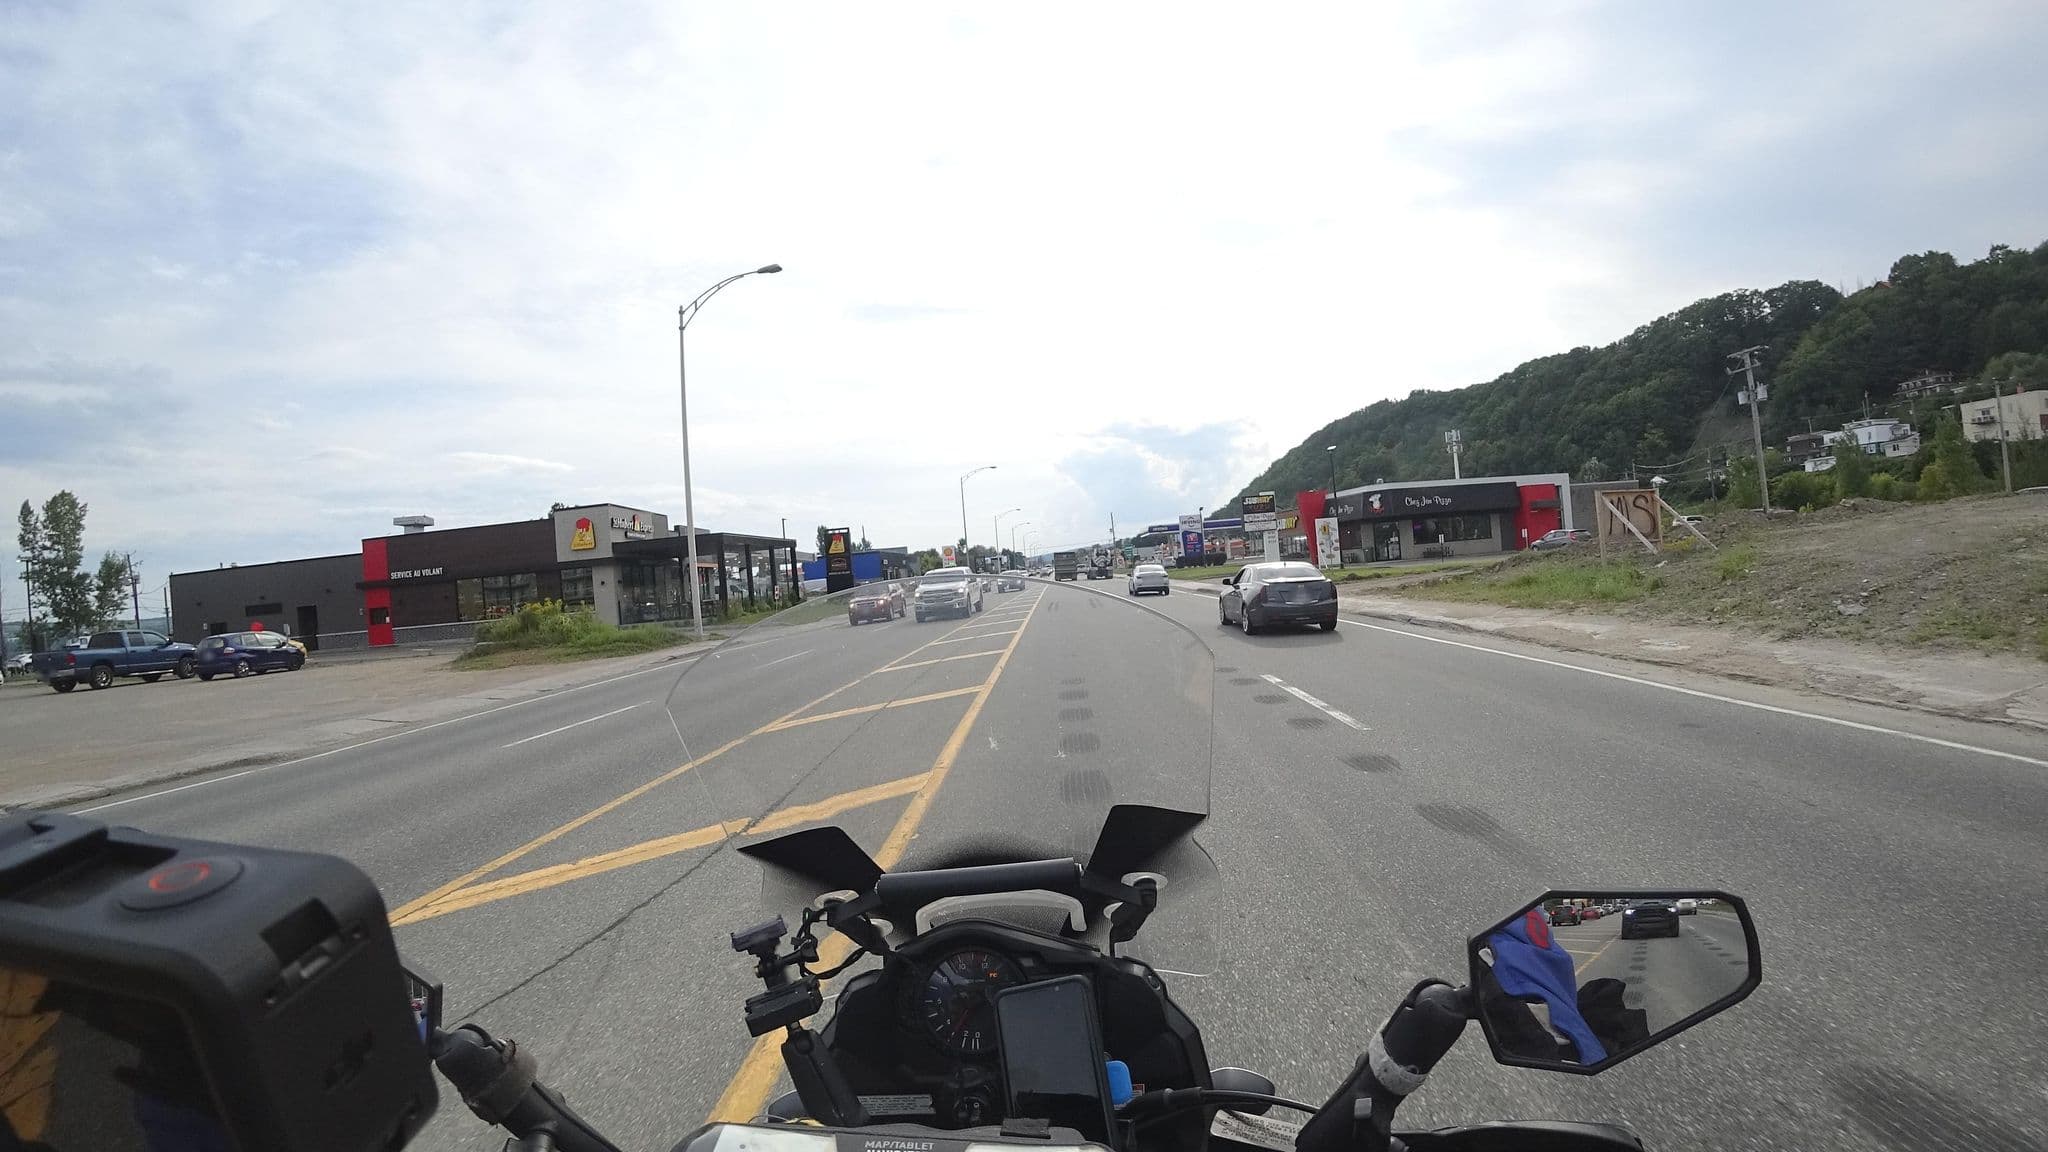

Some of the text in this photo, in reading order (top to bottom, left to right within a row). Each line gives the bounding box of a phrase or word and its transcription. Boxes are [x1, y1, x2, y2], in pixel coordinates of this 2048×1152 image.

[1243, 496, 1273, 505] SUBWAY
[391, 571, 412, 579] SERVICE
[422, 567, 443, 576] VOLANT
[864, 1141, 935, 1150] MAP/TABLET
